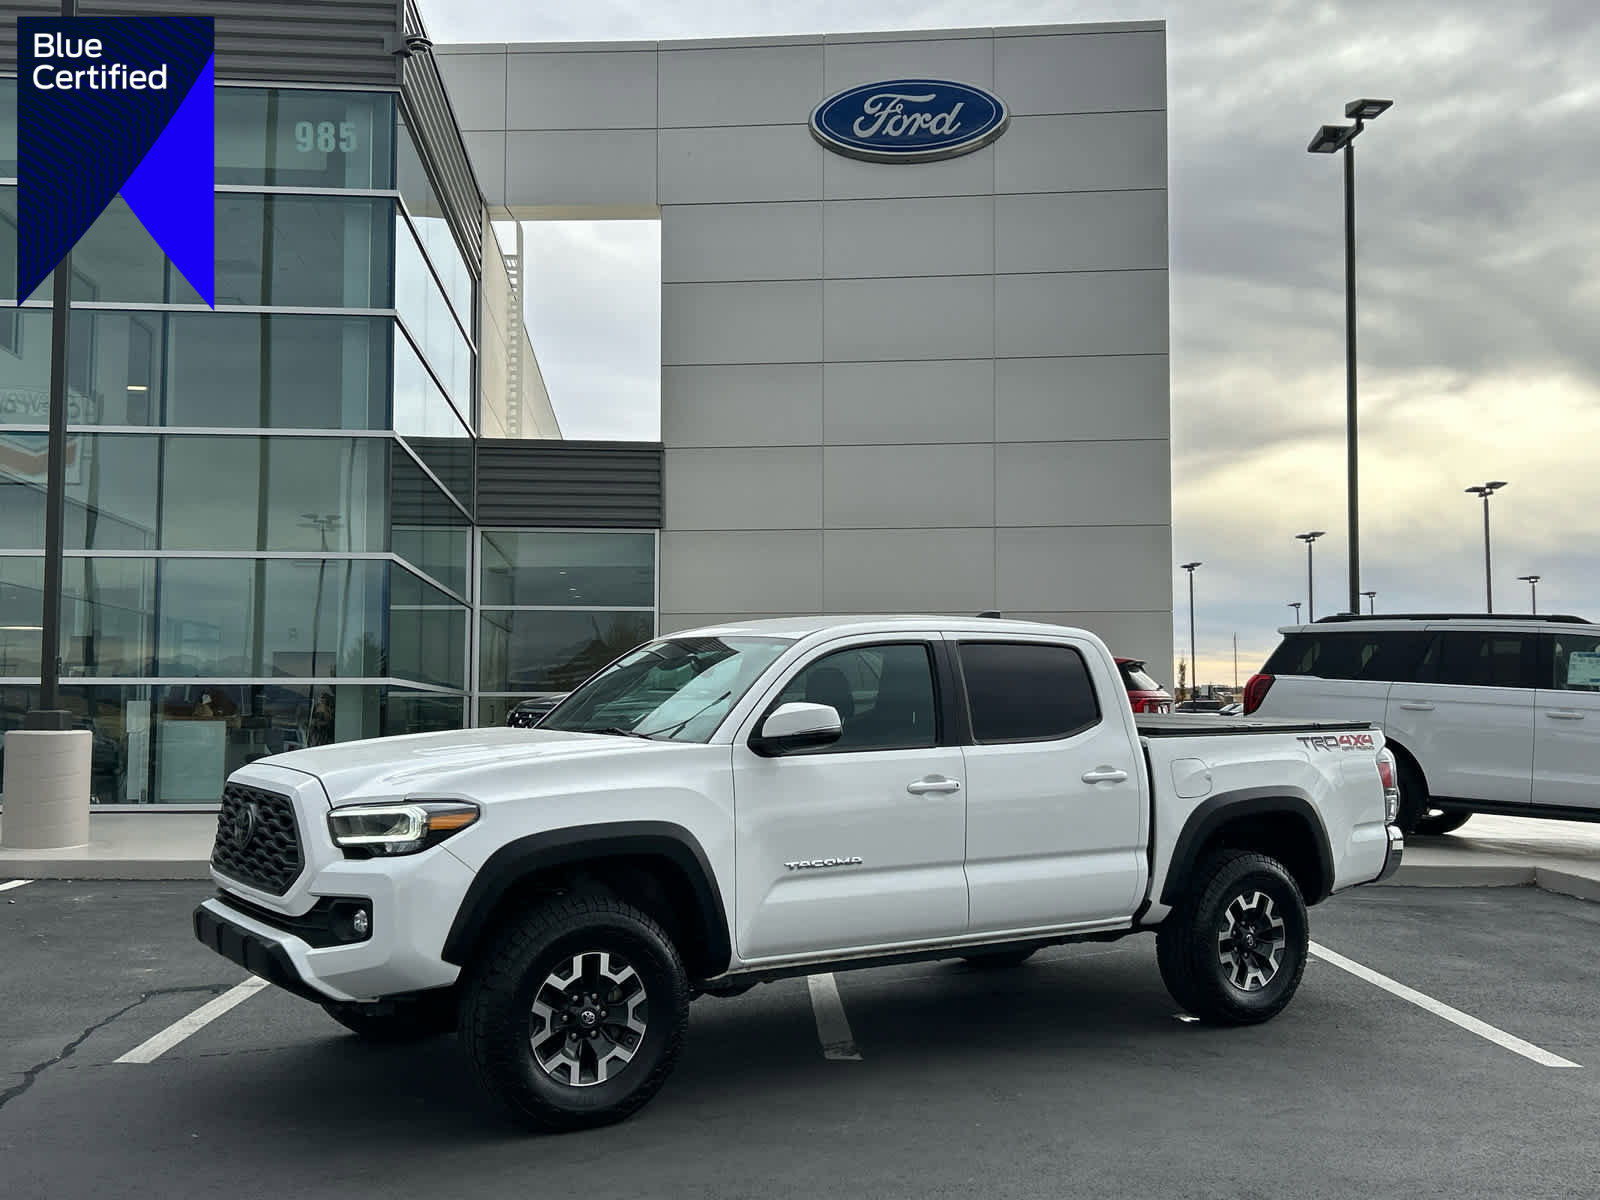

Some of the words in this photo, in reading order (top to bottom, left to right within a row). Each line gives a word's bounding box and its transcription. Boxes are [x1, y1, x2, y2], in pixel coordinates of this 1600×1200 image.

[853, 93, 965, 138] Ford
[295, 120, 357, 152] 985
[1296, 735, 1339, 752] TRD
[784, 856, 863, 870] TACOMA
